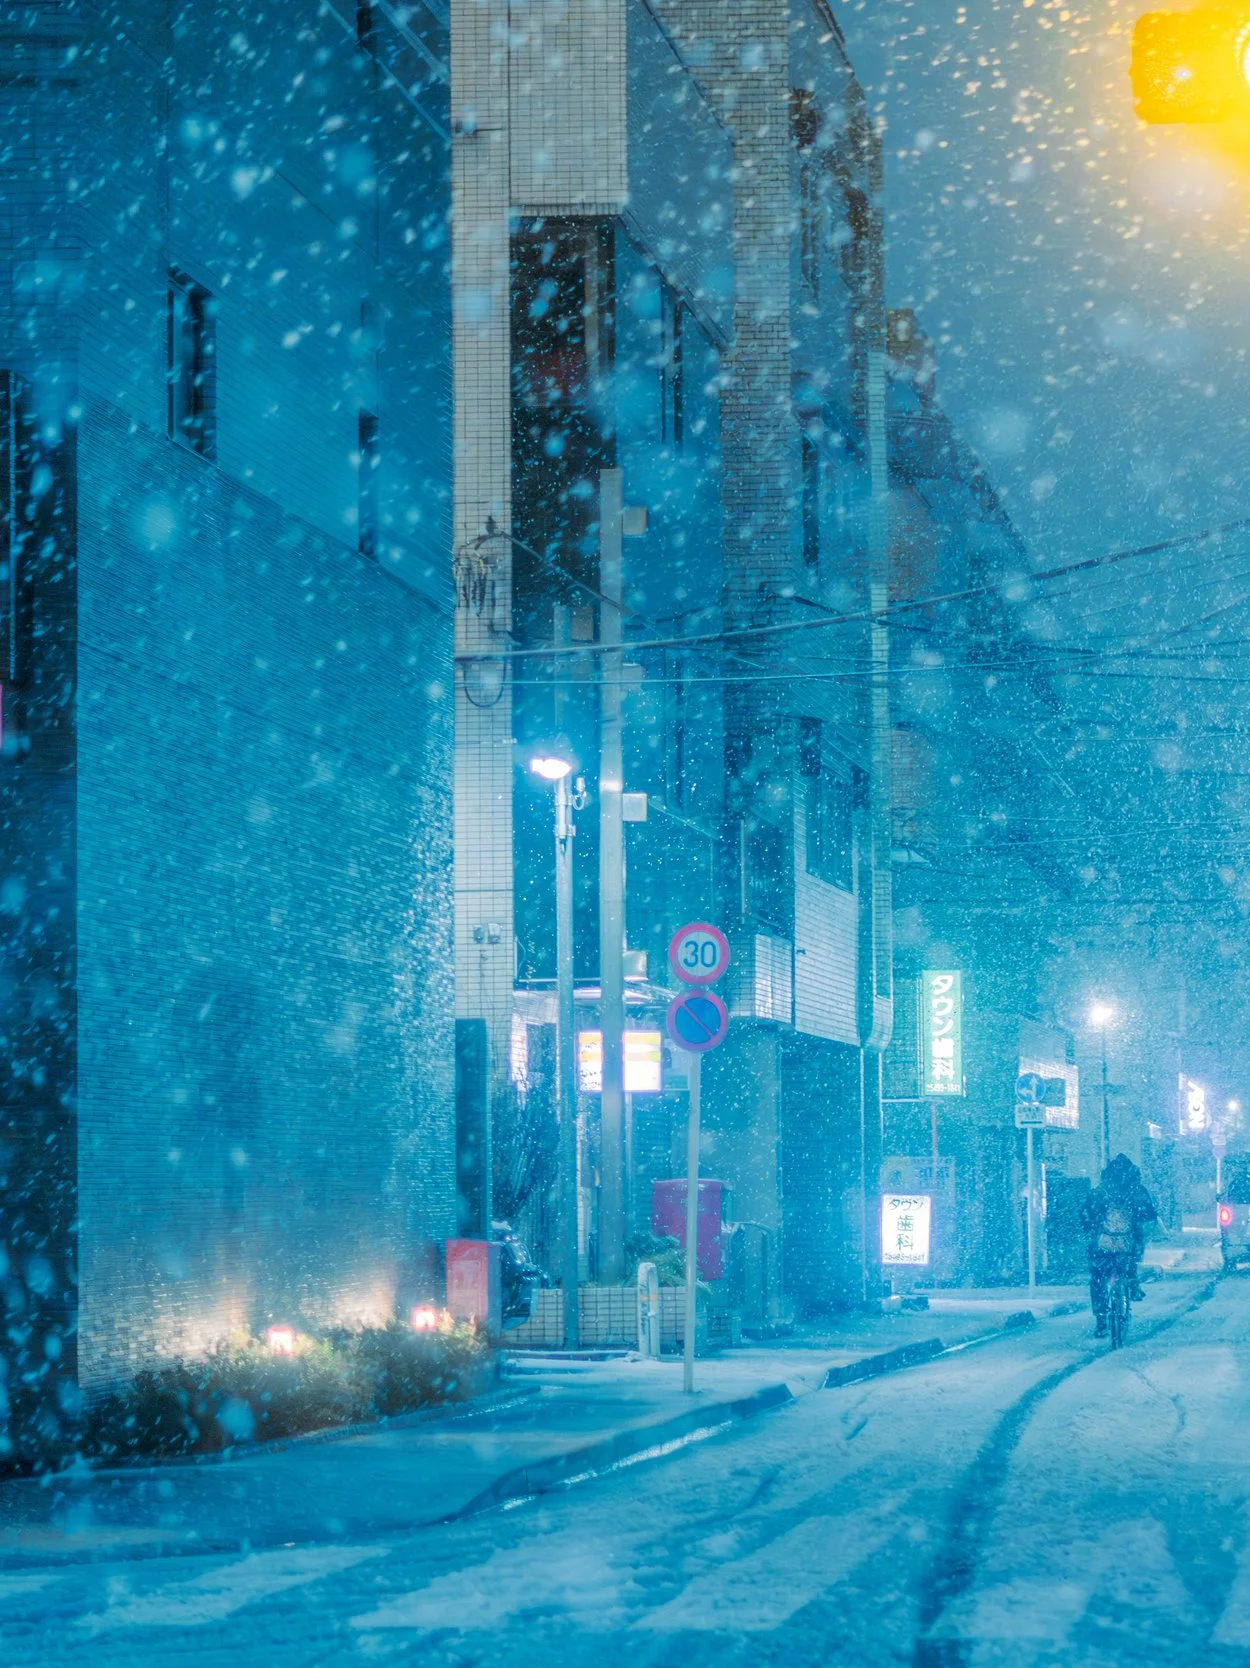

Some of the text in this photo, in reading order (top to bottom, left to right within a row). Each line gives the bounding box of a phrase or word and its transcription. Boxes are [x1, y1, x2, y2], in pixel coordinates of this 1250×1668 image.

[683, 940, 717, 968] 30
[889, 1198, 924, 1212] タウン
